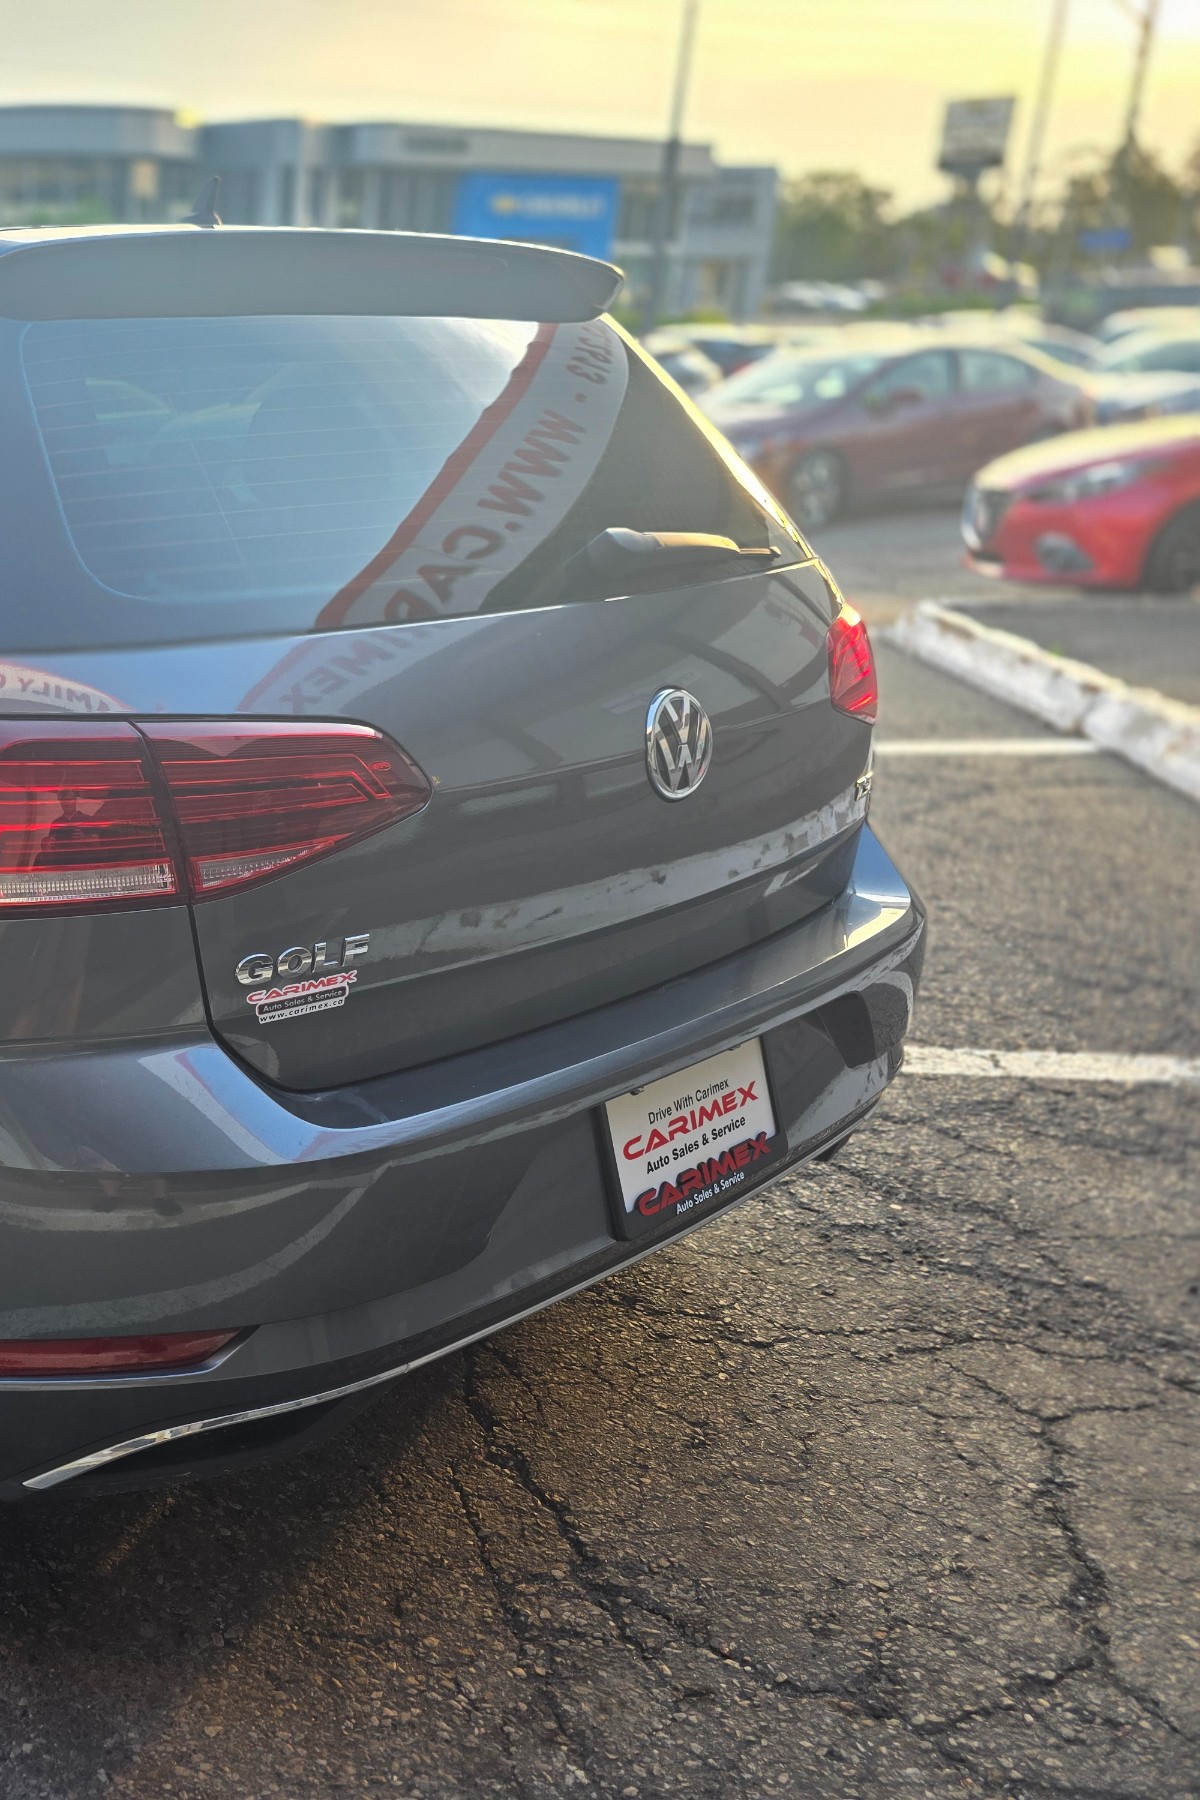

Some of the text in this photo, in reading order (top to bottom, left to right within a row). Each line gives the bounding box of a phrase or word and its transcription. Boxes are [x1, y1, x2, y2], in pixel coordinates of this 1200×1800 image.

[235, 934, 370, 986] GOLF
[247, 972, 356, 1003] CARIMEX
[263, 1002, 283, 1013] Auto
[284, 997, 306, 1008] Sales
[315, 989, 343, 1001] Service
[259, 999, 344, 1023] www.carimex.ca
[622, 1081, 758, 1161] CARIMEX
[648, 1079, 730, 1125] Drive With Carimex
[646, 1116, 746, 1174] Auto Sales & Service
[638, 1132, 772, 1216] CARIMEX
[676, 1171, 745, 1215] Auto Sales & Service
